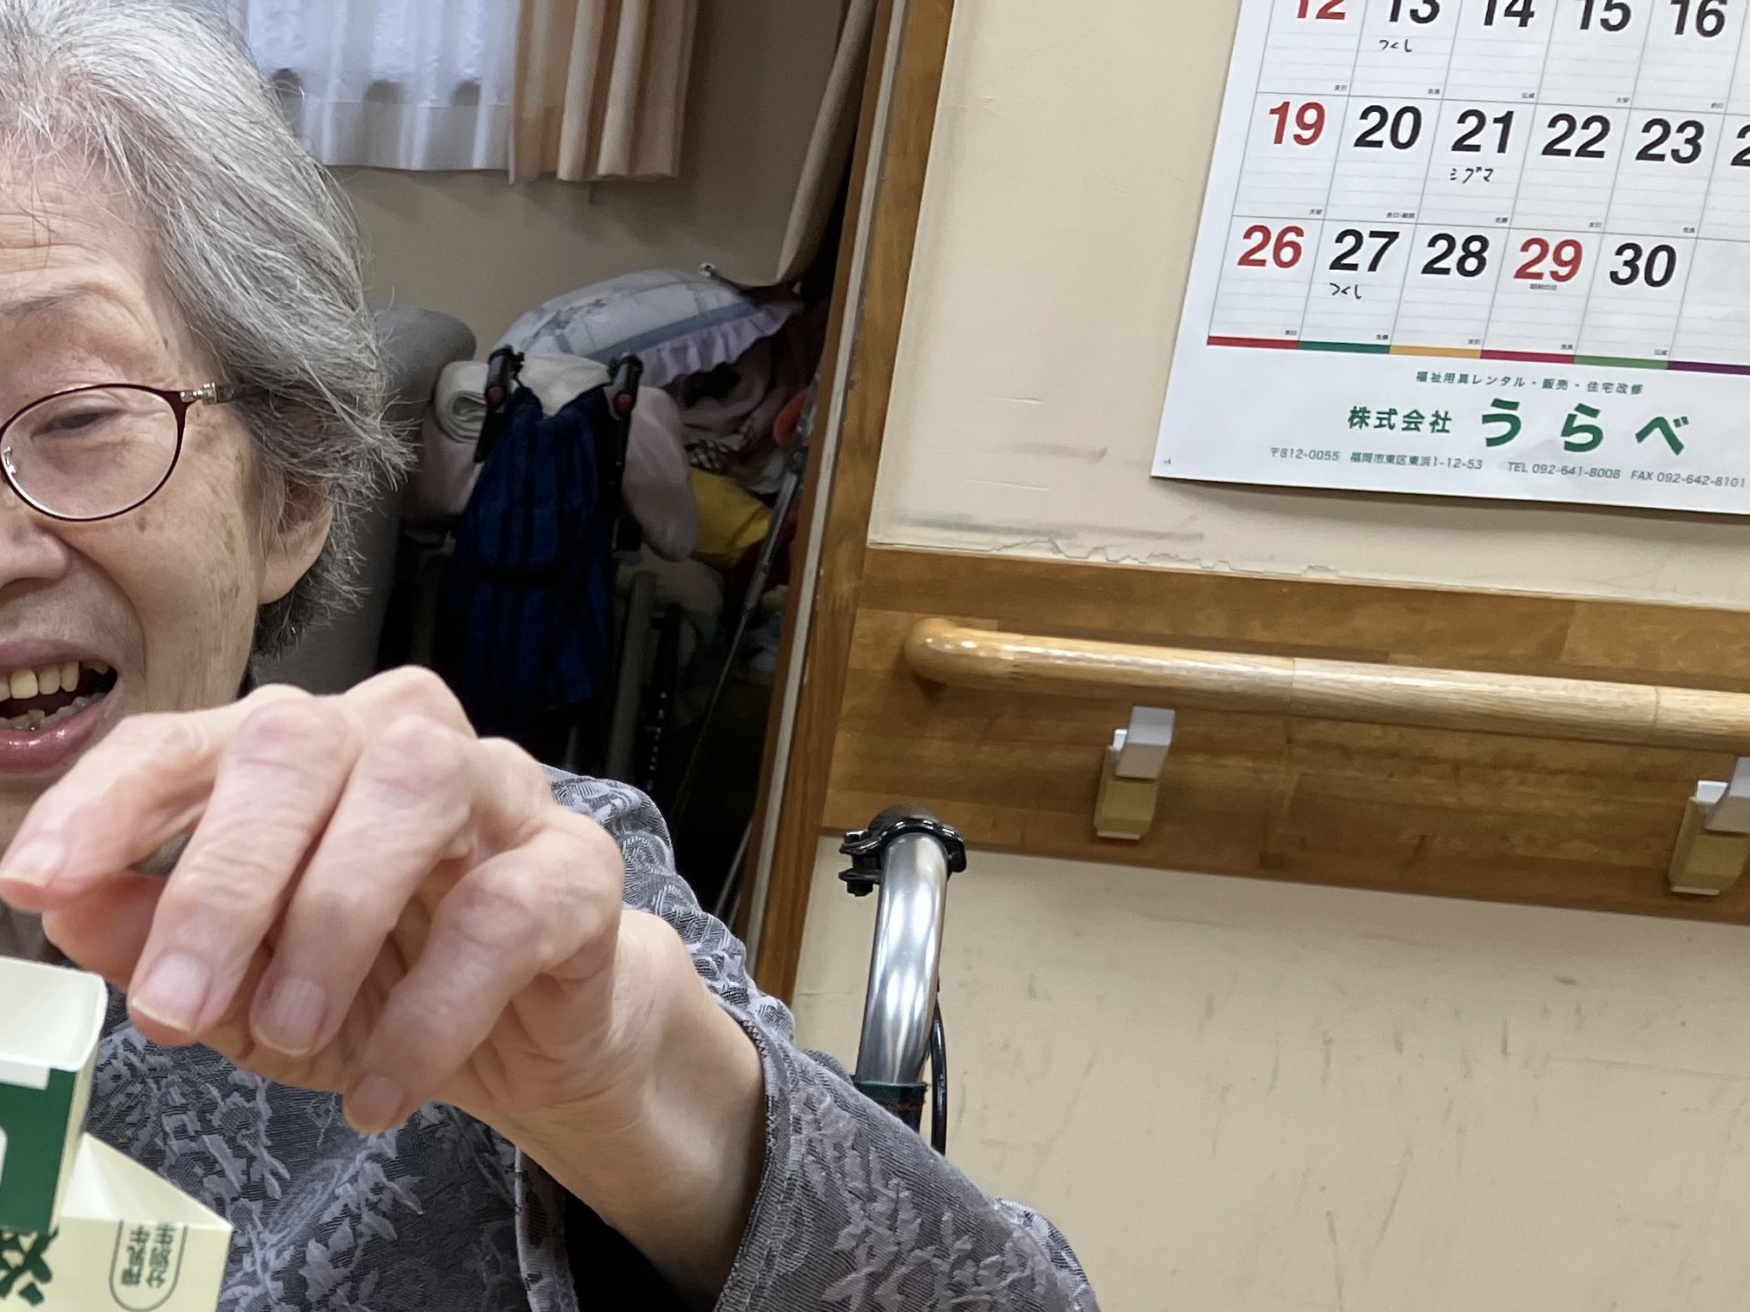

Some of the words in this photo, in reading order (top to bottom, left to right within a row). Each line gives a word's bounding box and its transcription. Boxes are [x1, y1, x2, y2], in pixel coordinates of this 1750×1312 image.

[1389, 0, 1440, 24] 13
[1483, 0, 1535, 27] 14
[1580, 0, 1632, 32] 15
[1670, 0, 1728, 37] 16
[1269, 101, 1325, 146] 19
[1354, 104, 1422, 150] 20
[1451, 109, 1514, 153] 21
[1541, 113, 1610, 158] 22
[1635, 118, 1705, 164] 23
[1730, 124, 1750, 167] 2
[1237, 224, 1305, 269] 26
[1329, 229, 1400, 272] 27
[1421, 232, 1490, 277] 28
[1513, 237, 1583, 283] 29
[1609, 242, 1677, 287] 30
[1348, 405, 1452, 434] 株式会社
[1481, 398, 1689, 456] うらべ
[1507, 461, 1528, 474] TEL
[1631, 470, 1653, 482] FAX
[1656, 472, 1746, 488] 092-642-8101
